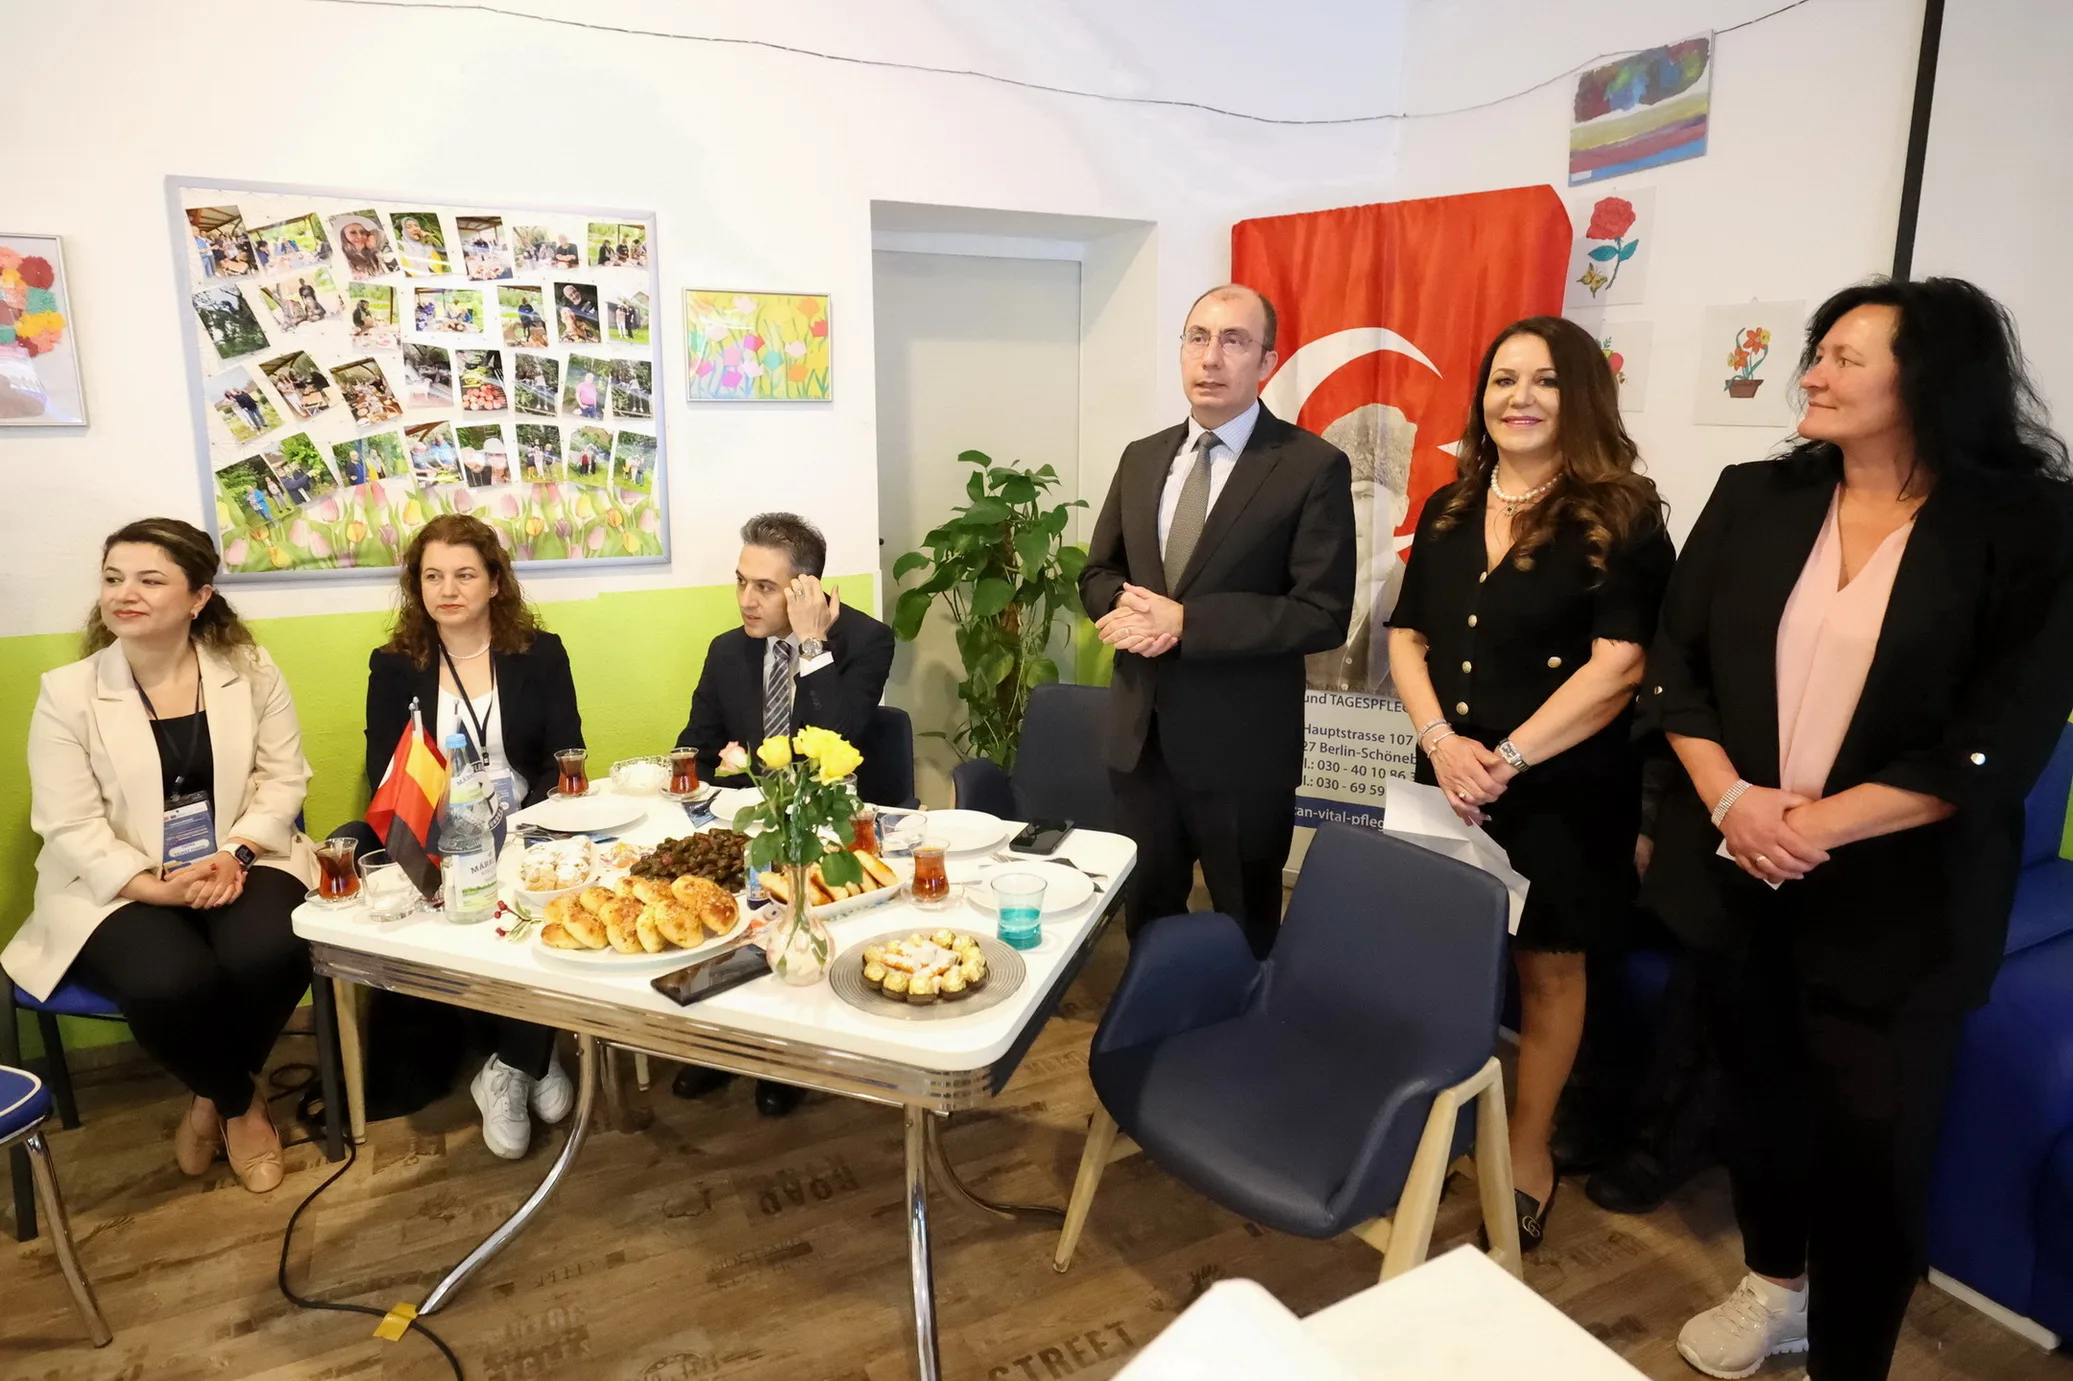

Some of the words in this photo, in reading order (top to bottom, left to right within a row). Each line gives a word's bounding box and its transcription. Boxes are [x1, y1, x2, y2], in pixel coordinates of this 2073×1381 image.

[1304, 723, 1385, 743] Hauptstrasse
[1390, 733, 1414, 746] 107
[1317, 759, 1340, 773] 030
[1351, 765, 1367, 777] 40
[1371, 767, 1386, 779] 10
[1316, 777, 1339, 790] 030
[1350, 782, 1366, 794] 69
[1369, 785, 1385, 796] 59
